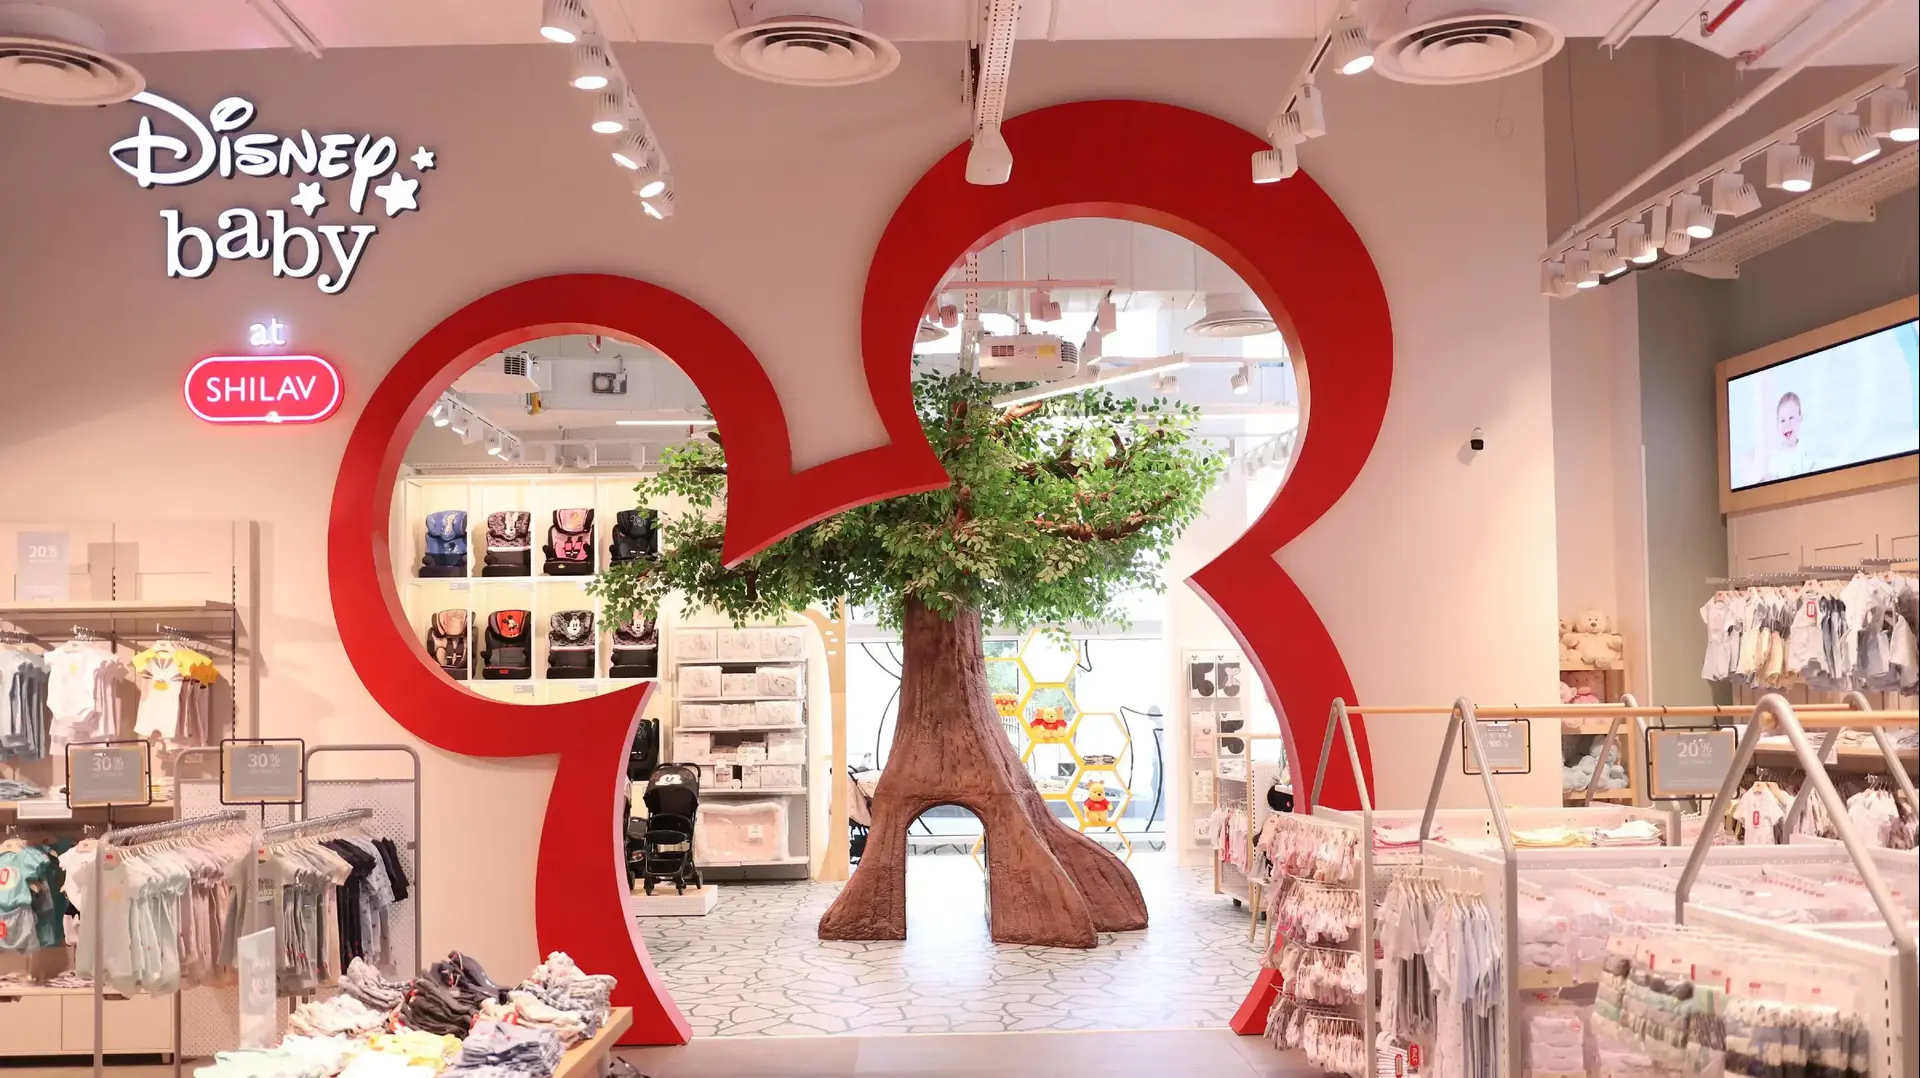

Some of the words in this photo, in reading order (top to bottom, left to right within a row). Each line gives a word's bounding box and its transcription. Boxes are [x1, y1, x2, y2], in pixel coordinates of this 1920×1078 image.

[160, 208, 377, 294] baby
[249, 317, 286, 347] at
[206, 376, 317, 402] SHILAV
[247, 753, 281, 768] 30%
[1677, 742, 1712, 757] 20%
